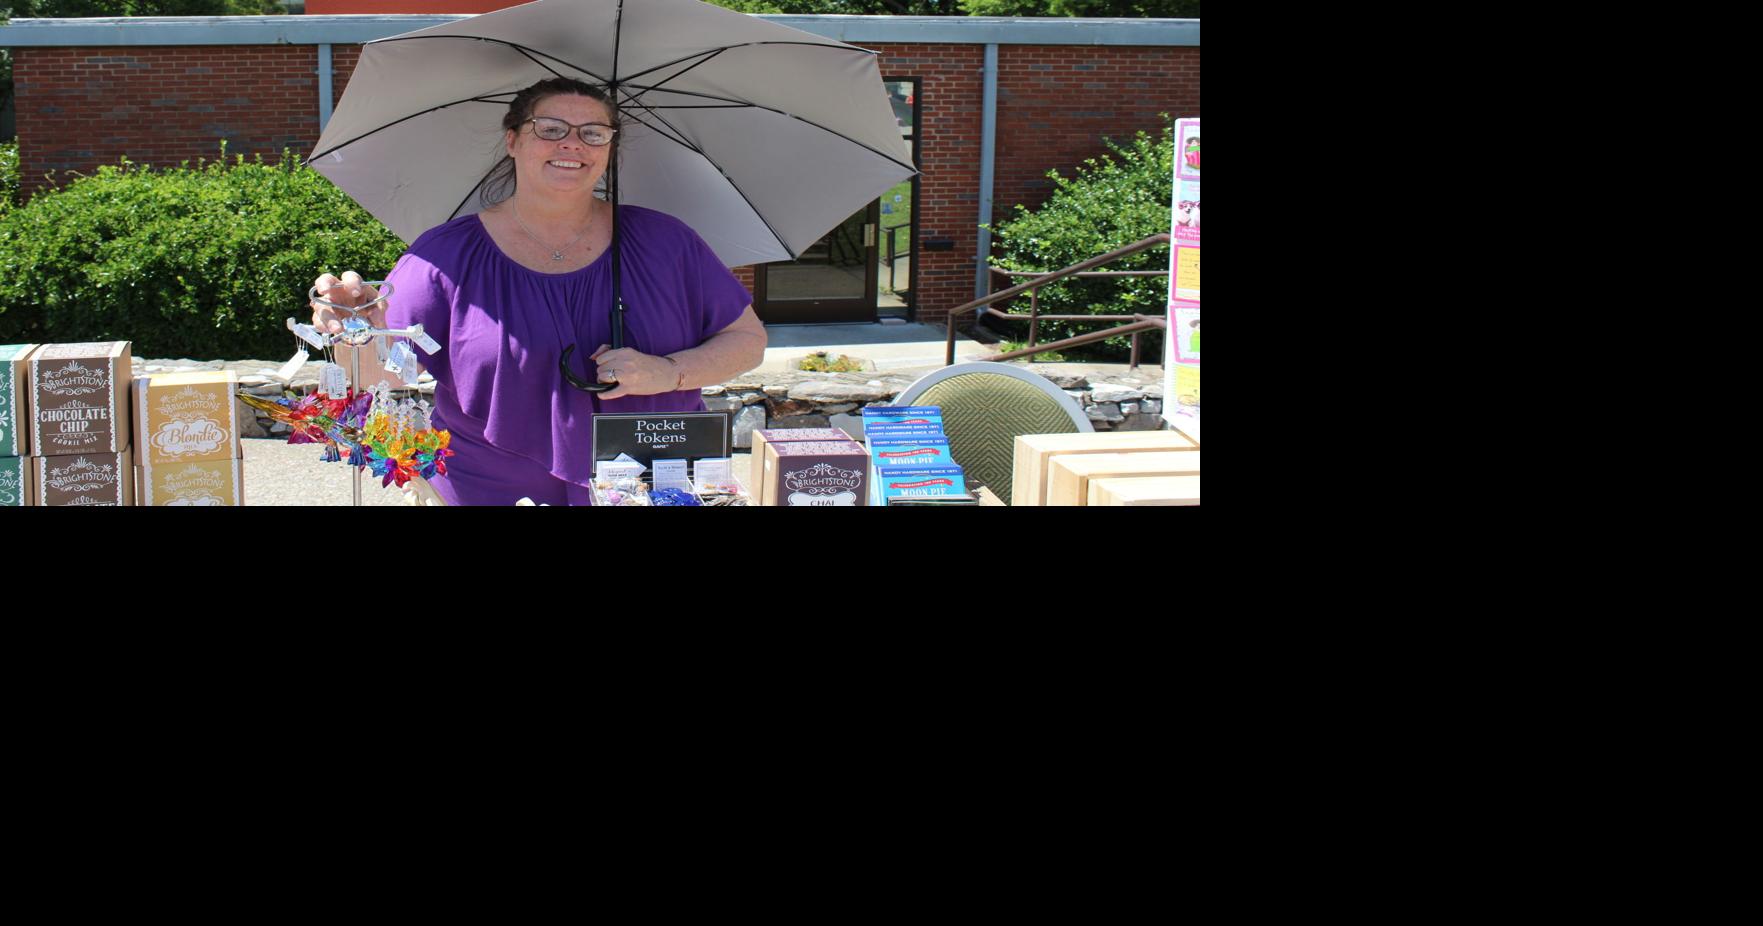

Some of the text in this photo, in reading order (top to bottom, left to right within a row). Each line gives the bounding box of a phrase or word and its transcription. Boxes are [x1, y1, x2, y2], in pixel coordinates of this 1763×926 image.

[47, 376, 108, 390] BRIGHTSTONE
[166, 400, 221, 413] BRIGHTSTONE
[40, 408, 108, 422] CHOCOLATE
[60, 420, 88, 432] CHIP
[636, 420, 686, 431] Pocket
[168, 423, 218, 443] Blondie
[634, 432, 687, 444] Tokens
[52, 437, 80, 446] COOKIE
[58, 471, 116, 486] BRIGHTSTONE
[797, 477, 856, 488] BRIGHTSTONE
[901, 488, 946, 496] MOON PIE
